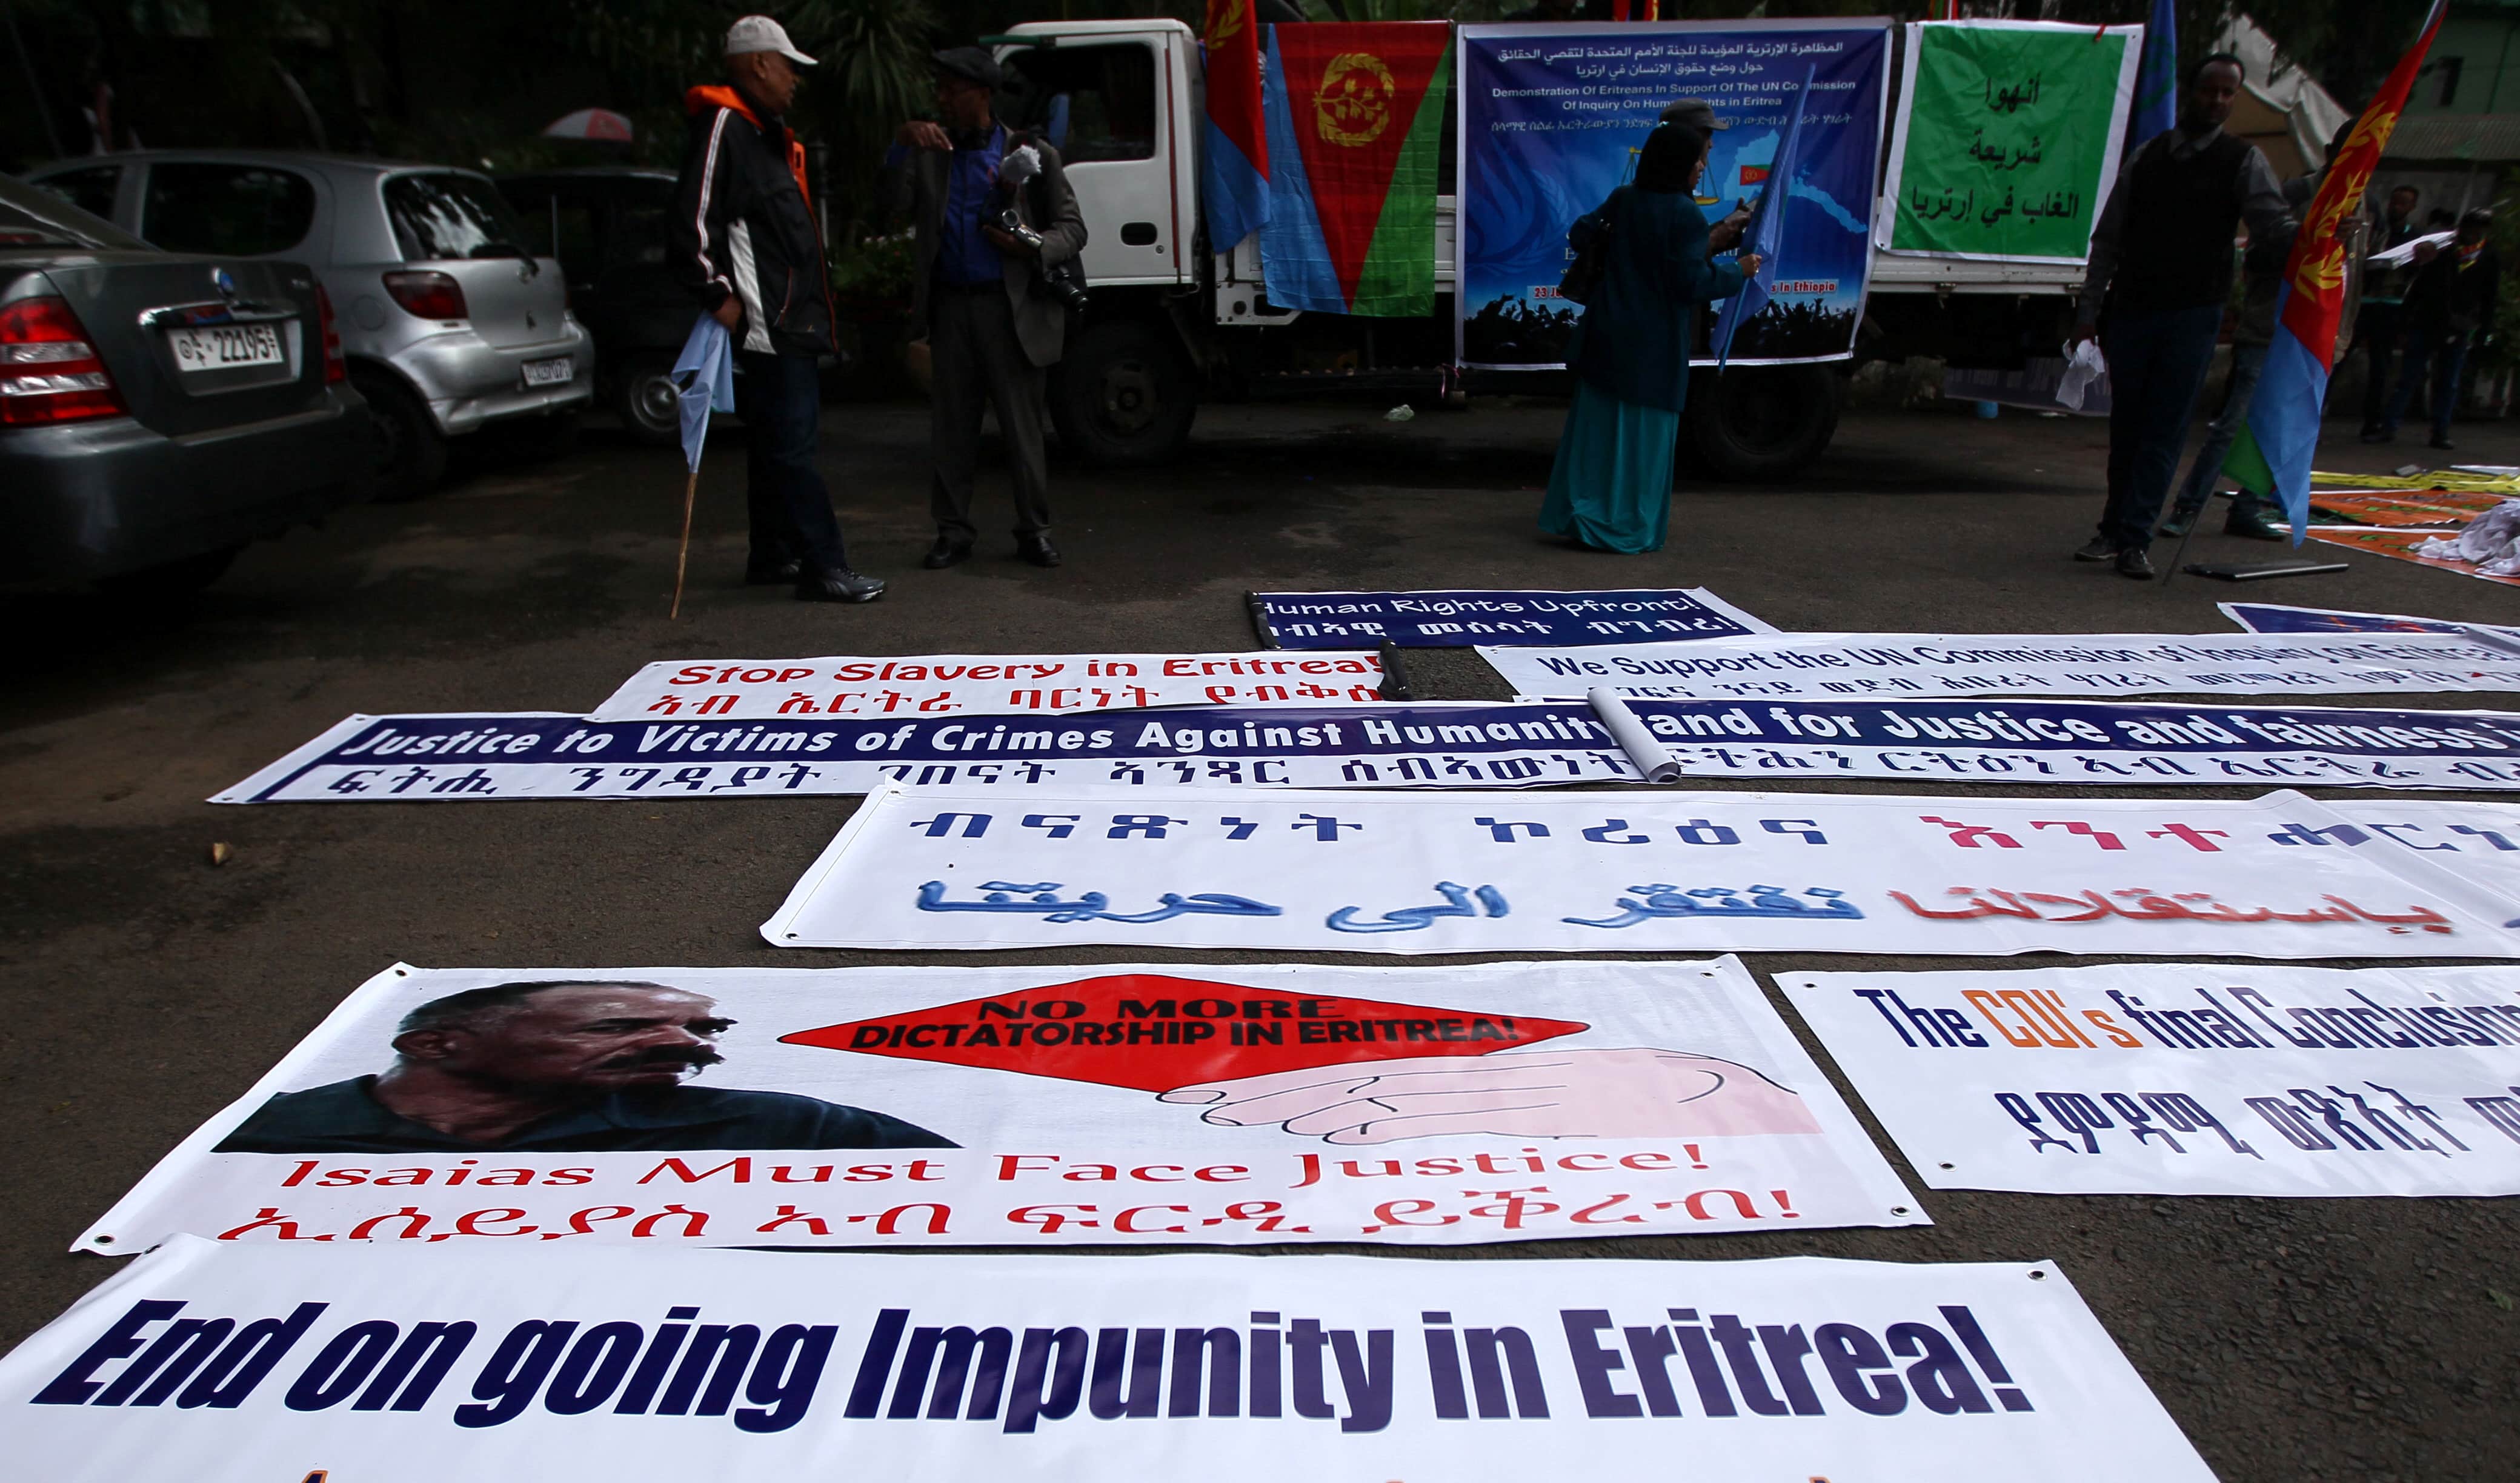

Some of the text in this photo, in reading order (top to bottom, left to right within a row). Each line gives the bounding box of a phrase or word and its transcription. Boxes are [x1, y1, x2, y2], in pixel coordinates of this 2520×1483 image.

[1492, 87, 1579, 97] Demonstration
[1583, 86, 1596, 95] Of
[1600, 85, 1652, 95] Eritreans
[1670, 83, 1717, 95] Support
[1720, 83, 1733, 92] Of
[1737, 82, 1758, 91] The
[1783, 81, 1855, 90] Comission
[1563, 101, 1575, 110] Of
[1579, 101, 1619, 112] Inquiry
[1623, 99, 1640, 108] On
[1644, 99, 1671, 108] Hum
[1730, 97, 1740, 105] in
[1743, 96, 1781, 106] Eritrea
[1969, 129, 2042, 170] شريعة
[1981, 187, 2013, 228] في
[2021, 193, 2079, 224] الغاب
[1535, 287, 1547, 298] 23
[1780, 282, 1790, 292] In
[1794, 281, 1836, 294] Ethiopia
[1391, 599, 1524, 617] Rights
[1529, 597, 1703, 617] Upfront!
[669, 666, 814, 684] Stop
[834, 662, 1065, 682] Slavery
[1088, 659, 1138, 677] in
[1537, 656, 1609, 676] We
[1620, 652, 1777, 679] Support
[1775, 650, 1850, 668] the
[1844, 647, 1920, 667] UN
[1913, 645, 2154, 664] Commission
[2147, 645, 2187, 662] of
[2178, 645, 2340, 664] Inquiry
[2323, 648, 2385, 660] on
[340, 728, 541, 755] Justice
[552, 728, 613, 754] to
[636, 724, 839, 758] Victims
[855, 724, 913, 751] of
[931, 725, 1112, 751] Crimes
[1135, 722, 1341, 753] Against
[1634, 707, 1763, 737] and
[1770, 707, 1862, 738] for
[1883, 708, 2109, 742] Justice
[2116, 715, 2242, 745] and
[2233, 714, 2508, 749] fairness
[980, 997, 1341, 1019] NO MORE
[1853, 989, 1989, 1047] The
[2105, 988, 2276, 1049] final
[848, 1018, 1518, 1048] DICTATORSHIP IN ERITREA!
[281, 1144, 1710, 1188] Isaias Must Face Justice!
[29, 1299, 2034, 1433] End on going Impunity in Eritrea!
